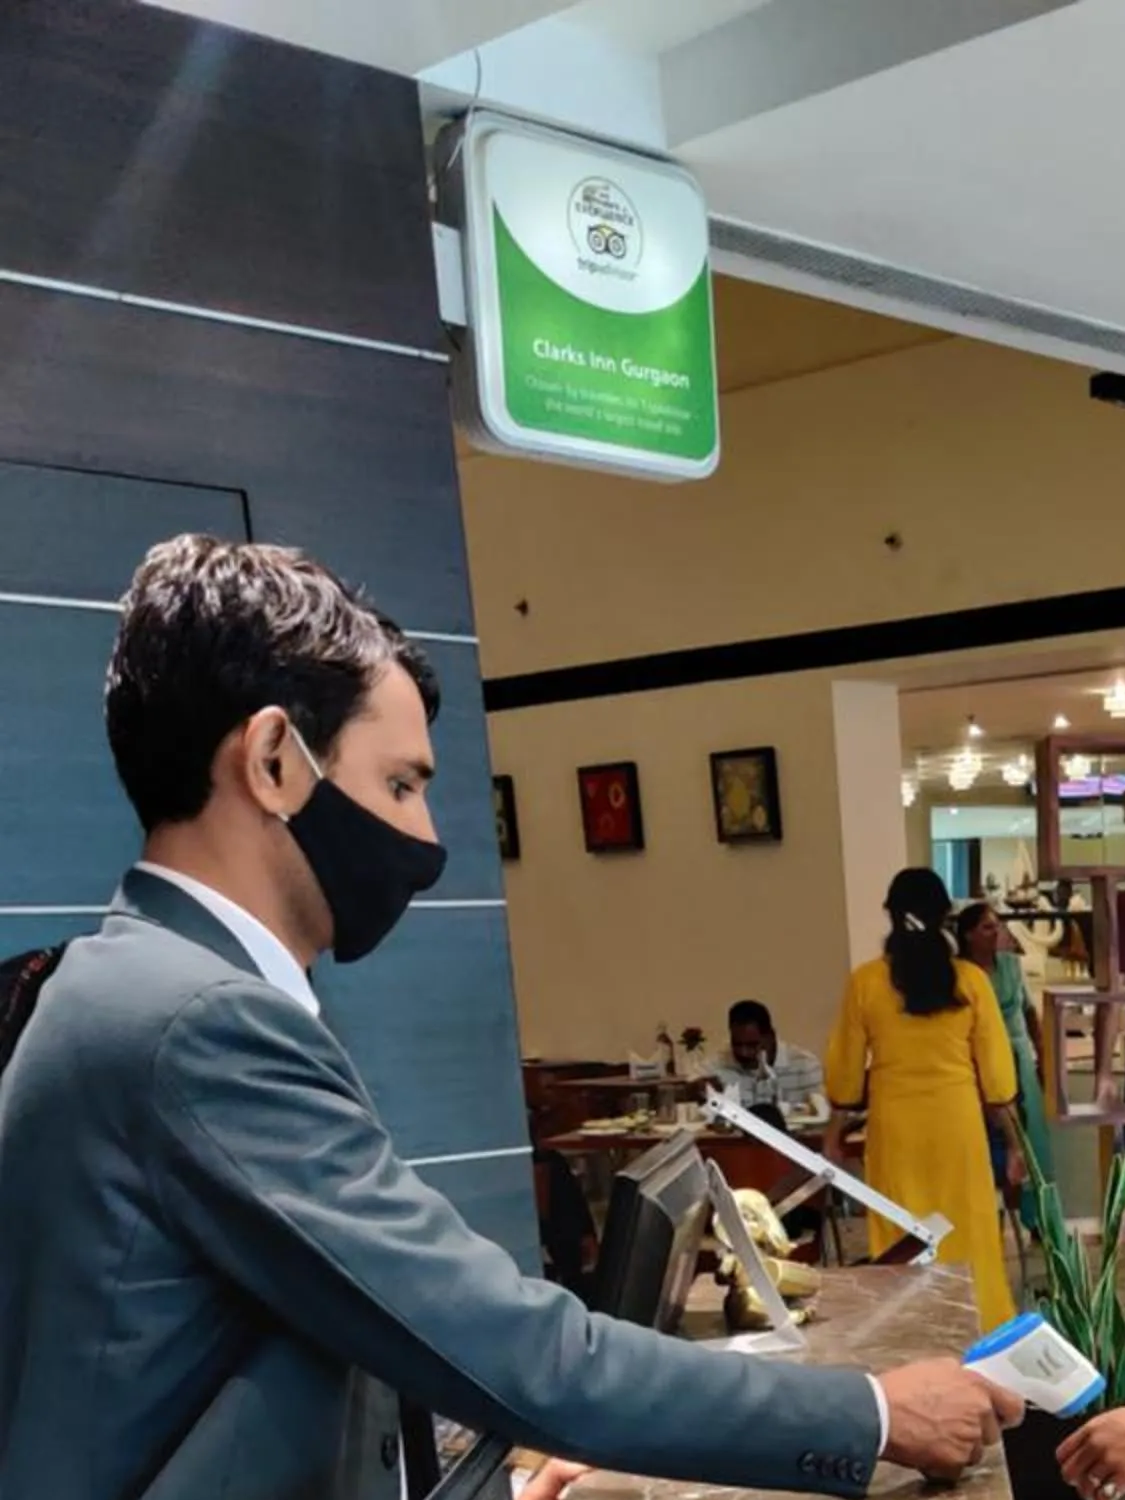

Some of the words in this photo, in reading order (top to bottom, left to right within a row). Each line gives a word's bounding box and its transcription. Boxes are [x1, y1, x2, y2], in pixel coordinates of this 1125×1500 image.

[532, 338, 587, 366] Clarks
[590, 351, 616, 374] Inn
[621, 358, 691, 390] Gurgaon
